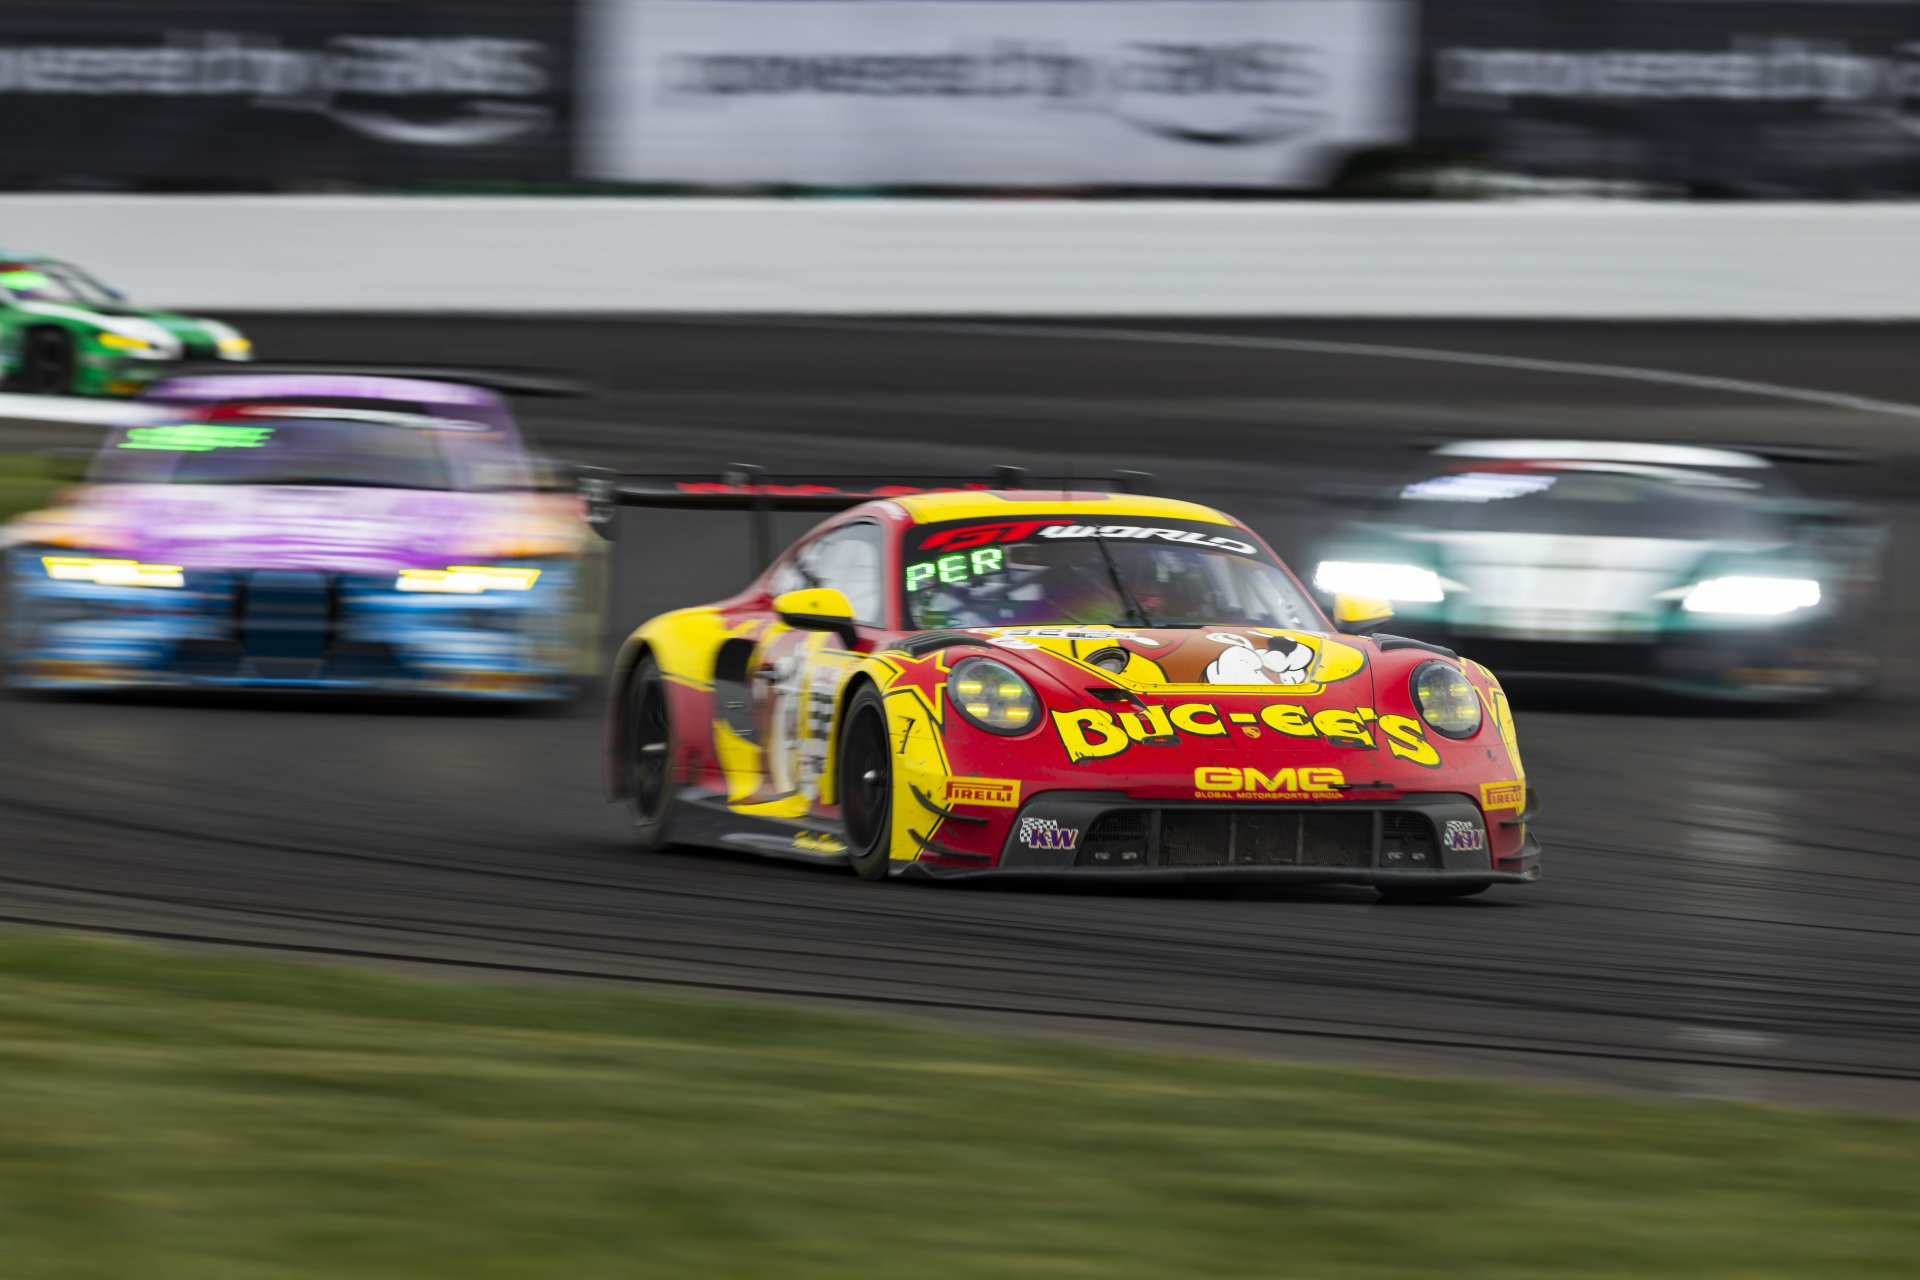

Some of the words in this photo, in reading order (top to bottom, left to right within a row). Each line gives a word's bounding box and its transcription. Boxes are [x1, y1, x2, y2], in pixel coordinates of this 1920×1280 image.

[918, 520, 1078, 551] GT
[1037, 525, 1258, 555] WORLD
[906, 548, 1003, 592] PER
[1194, 767, 1345, 791] GMG
[946, 781, 1014, 802] PIRELLI
[1194, 791, 1233, 799] GLOBAL
[1236, 792, 1310, 800] MOTORSPORTS
[1485, 785, 1522, 805] PIRELLI
[1028, 828, 1079, 849] KW
